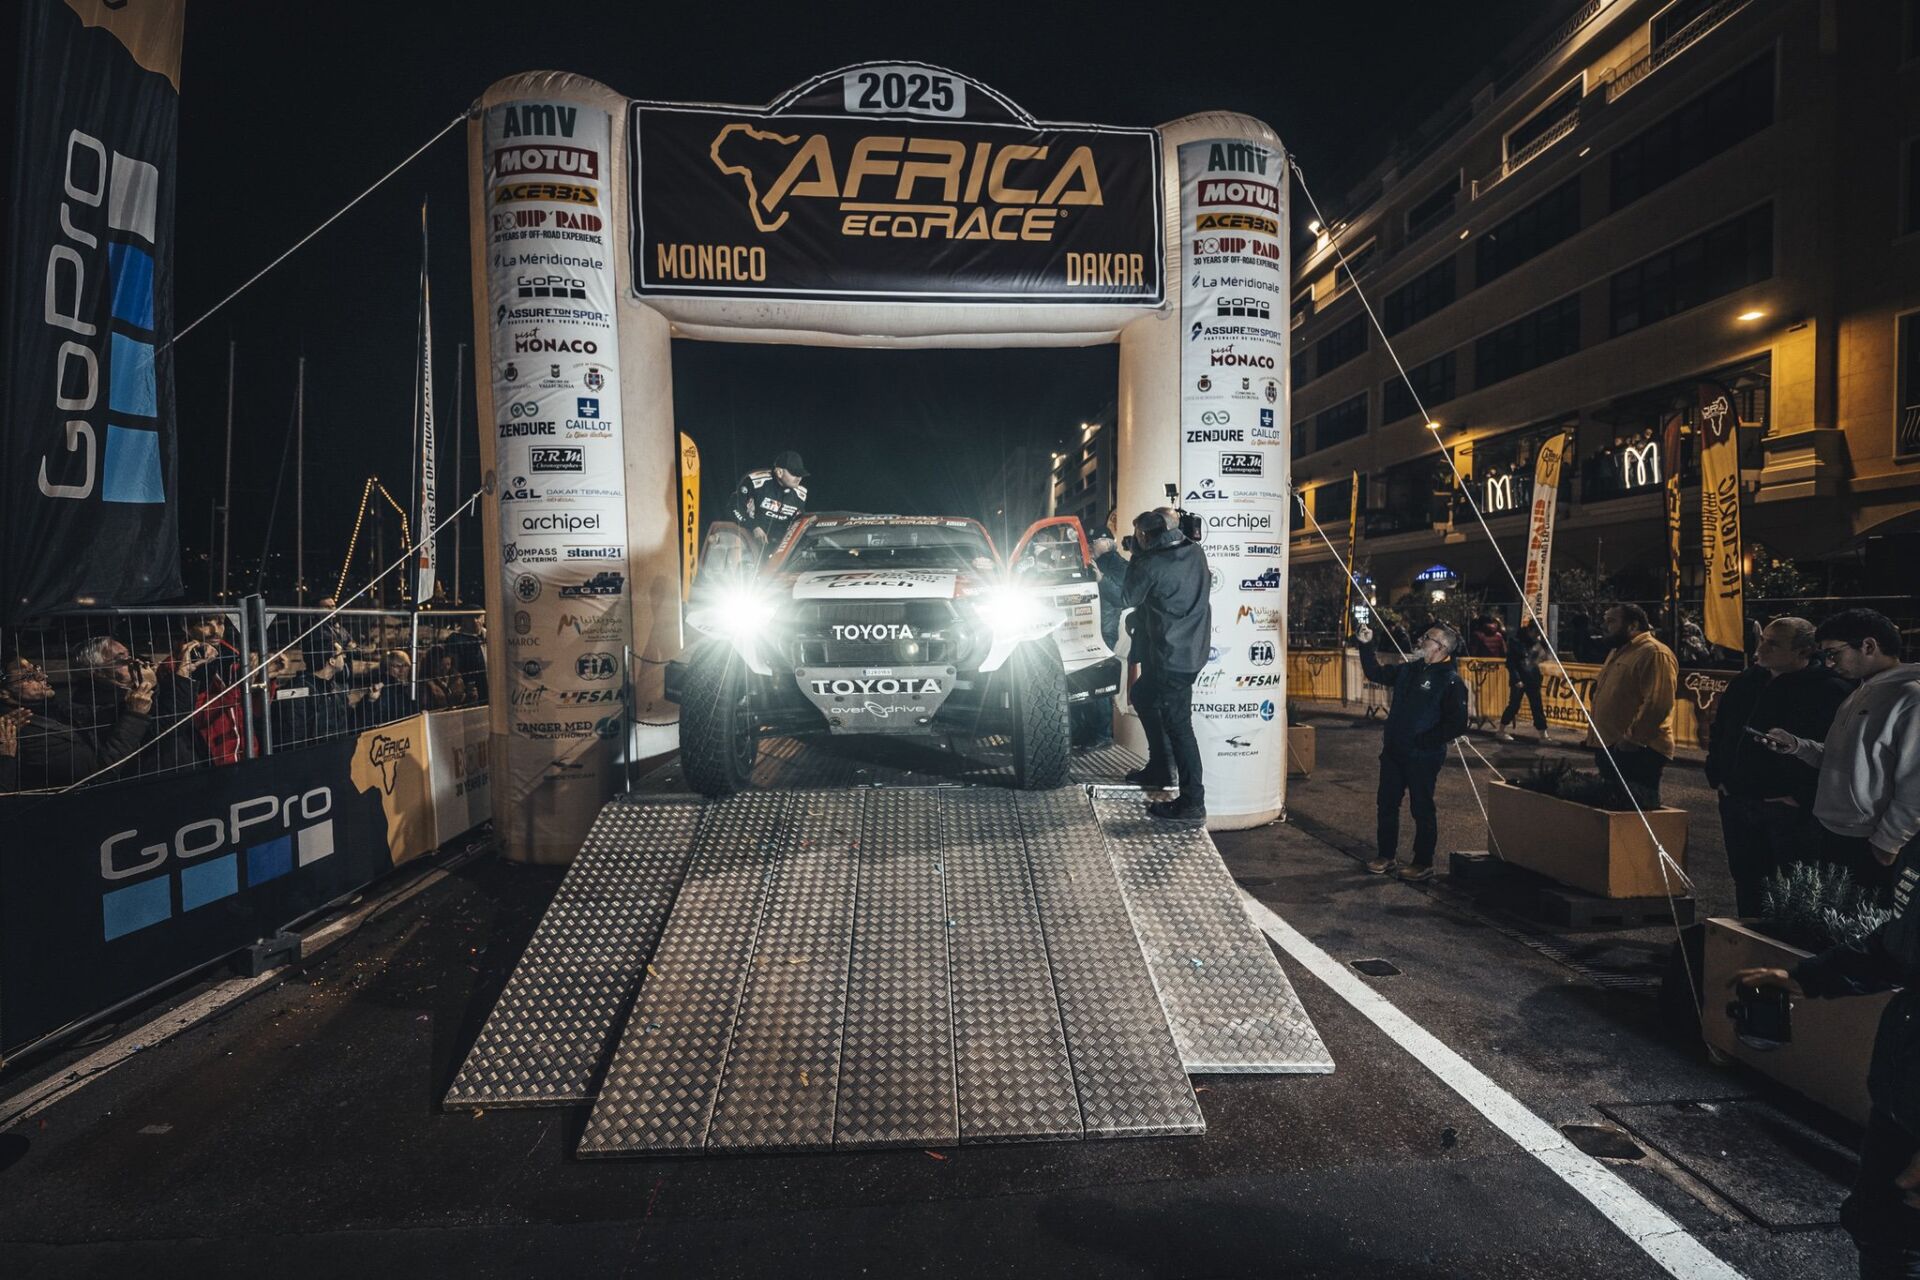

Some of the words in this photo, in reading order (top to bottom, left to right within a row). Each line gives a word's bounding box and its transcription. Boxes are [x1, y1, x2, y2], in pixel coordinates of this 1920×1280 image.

[858, 72, 954, 112] 2025
[500, 149, 594, 174] MOTUL
[762, 134, 1104, 213] AFRICA
[1203, 182, 1277, 209] MOTUL
[501, 231, 520, 240] YEARS
[520, 231, 527, 240] OF
[529, 230, 560, 240] OFF-ROAD
[562, 231, 603, 245] EXPERIENCE
[502, 257, 517, 268] La
[520, 253, 603, 270] Méridionale
[657, 243, 766, 281] MONACO
[1193, 257, 1202, 266] 30
[1203, 256, 1221, 265] YEARS
[1223, 255, 1230, 264] OF
[1231, 255, 1255, 265] OFF-ROAD
[1066, 252, 1144, 286] DAKAR
[517, 275, 585, 288] GoPro
[1203, 277, 1217, 288] La
[1220, 276, 1280, 294] Méridionale
[1217, 296, 1270, 309] GoPro
[38, 129, 107, 499] GoPro
[508, 308, 551, 319] ASSURE
[553, 308, 571, 316] TON
[515, 327, 540, 339] visit
[1204, 326, 1246, 335] ASSURE
[1260, 328, 1281, 340] SPORT
[515, 339, 598, 354] MONACO
[1211, 343, 1235, 354] visit
[1211, 354, 1274, 369] MONACO
[499, 422, 556, 438] ZENDURE
[565, 419, 612, 431] CAILLOT
[1187, 429, 1244, 443] ZENDURE
[1251, 428, 1280, 439] CAILLOT
[501, 488, 542, 500] AGL
[1185, 490, 1229, 500] AGL
[522, 513, 600, 533] archipel
[1209, 513, 1271, 531] archipel
[567, 547, 621, 558] stand21
[1247, 545, 1281, 555] stand21
[832, 624, 914, 640] TOYOTA
[508, 637, 541, 647] MAROC
[1197, 669, 1226, 688] isit
[811, 678, 942, 695] TOYOTA
[1191, 703, 1236, 712] TANGER
[1238, 702, 1259, 712] MED
[516, 722, 562, 733] TANGER
[565, 721, 593, 731] MED
[375, 737, 411, 760] AFRICA
[100, 786, 333, 880] GoPro
